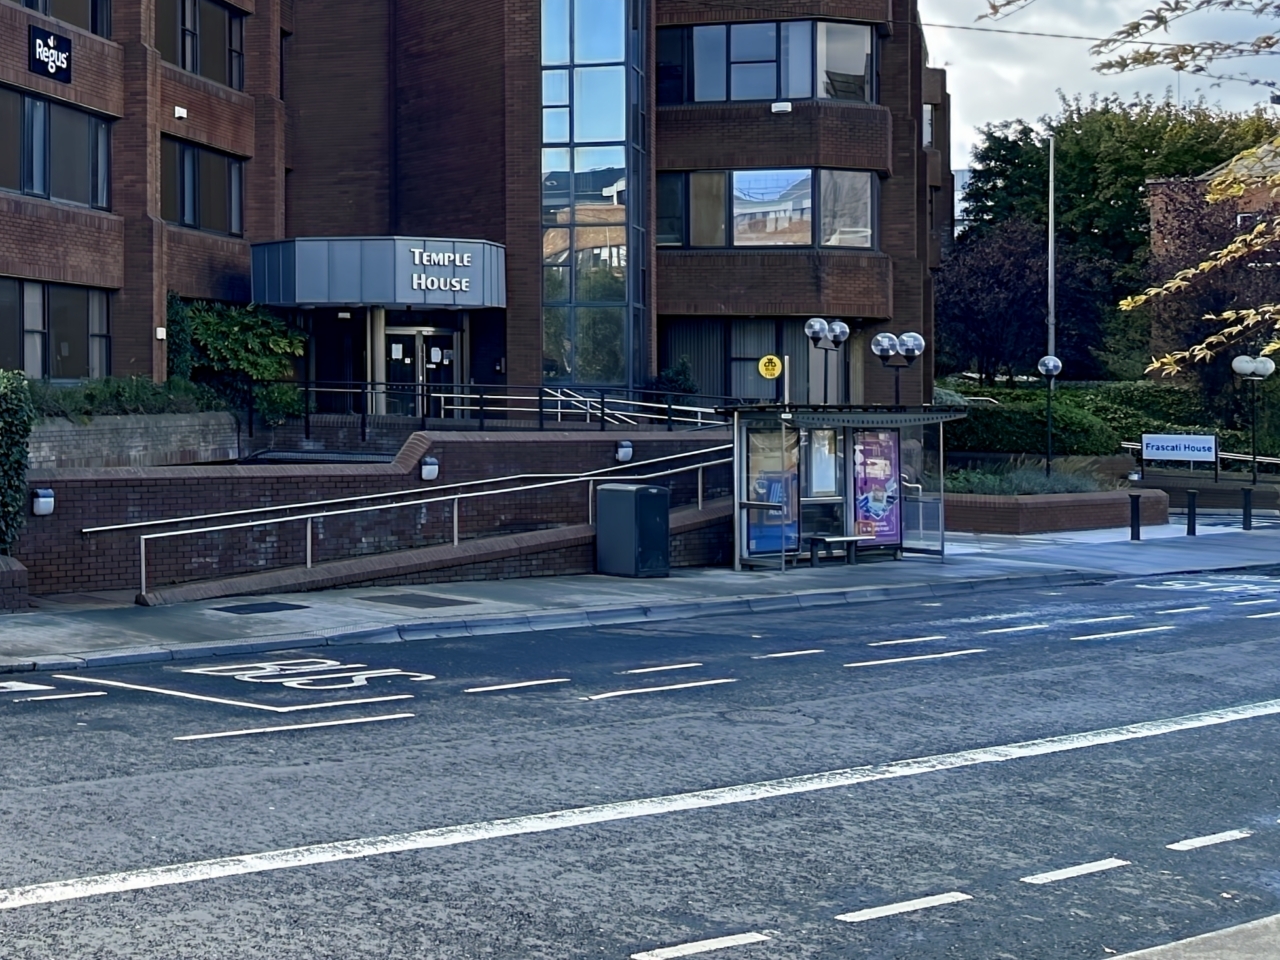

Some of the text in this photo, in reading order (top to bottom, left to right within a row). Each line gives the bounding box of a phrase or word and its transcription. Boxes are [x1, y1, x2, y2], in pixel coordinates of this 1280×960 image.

[35, 37, 68, 73] Regus
[410, 248, 472, 267] TEMPLE
[412, 273, 470, 291] HOUSE
[1145, 442, 1213, 453] Frascati House
[181, 658, 436, 690] BUS
